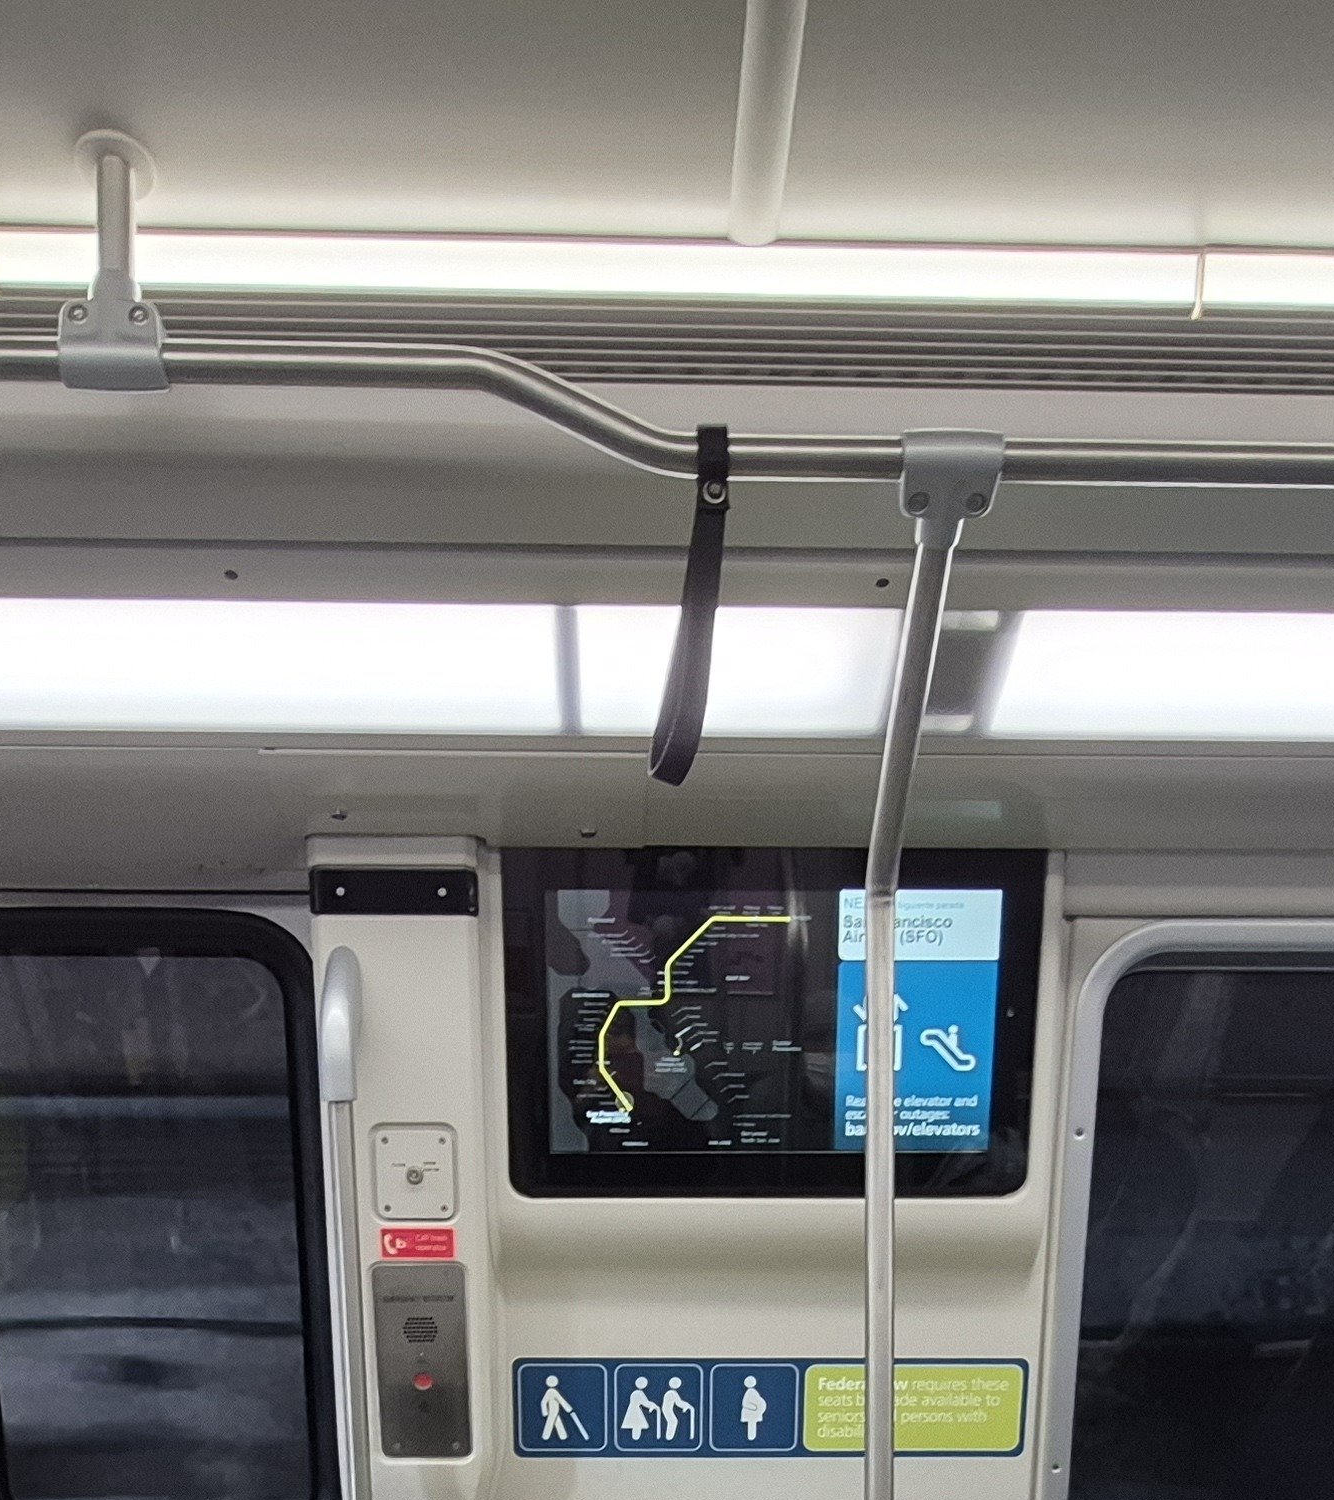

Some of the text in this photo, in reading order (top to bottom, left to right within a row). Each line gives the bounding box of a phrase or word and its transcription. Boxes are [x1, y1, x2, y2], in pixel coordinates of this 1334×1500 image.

[900, 930, 944, 946] (SFO)
[903, 1095, 953, 1107] elevator
[954, 1095, 979, 1107] and
[921, 1393, 982, 1407] available
[986, 1394, 1001, 1407] to
[901, 1412, 953, 1426] persons
